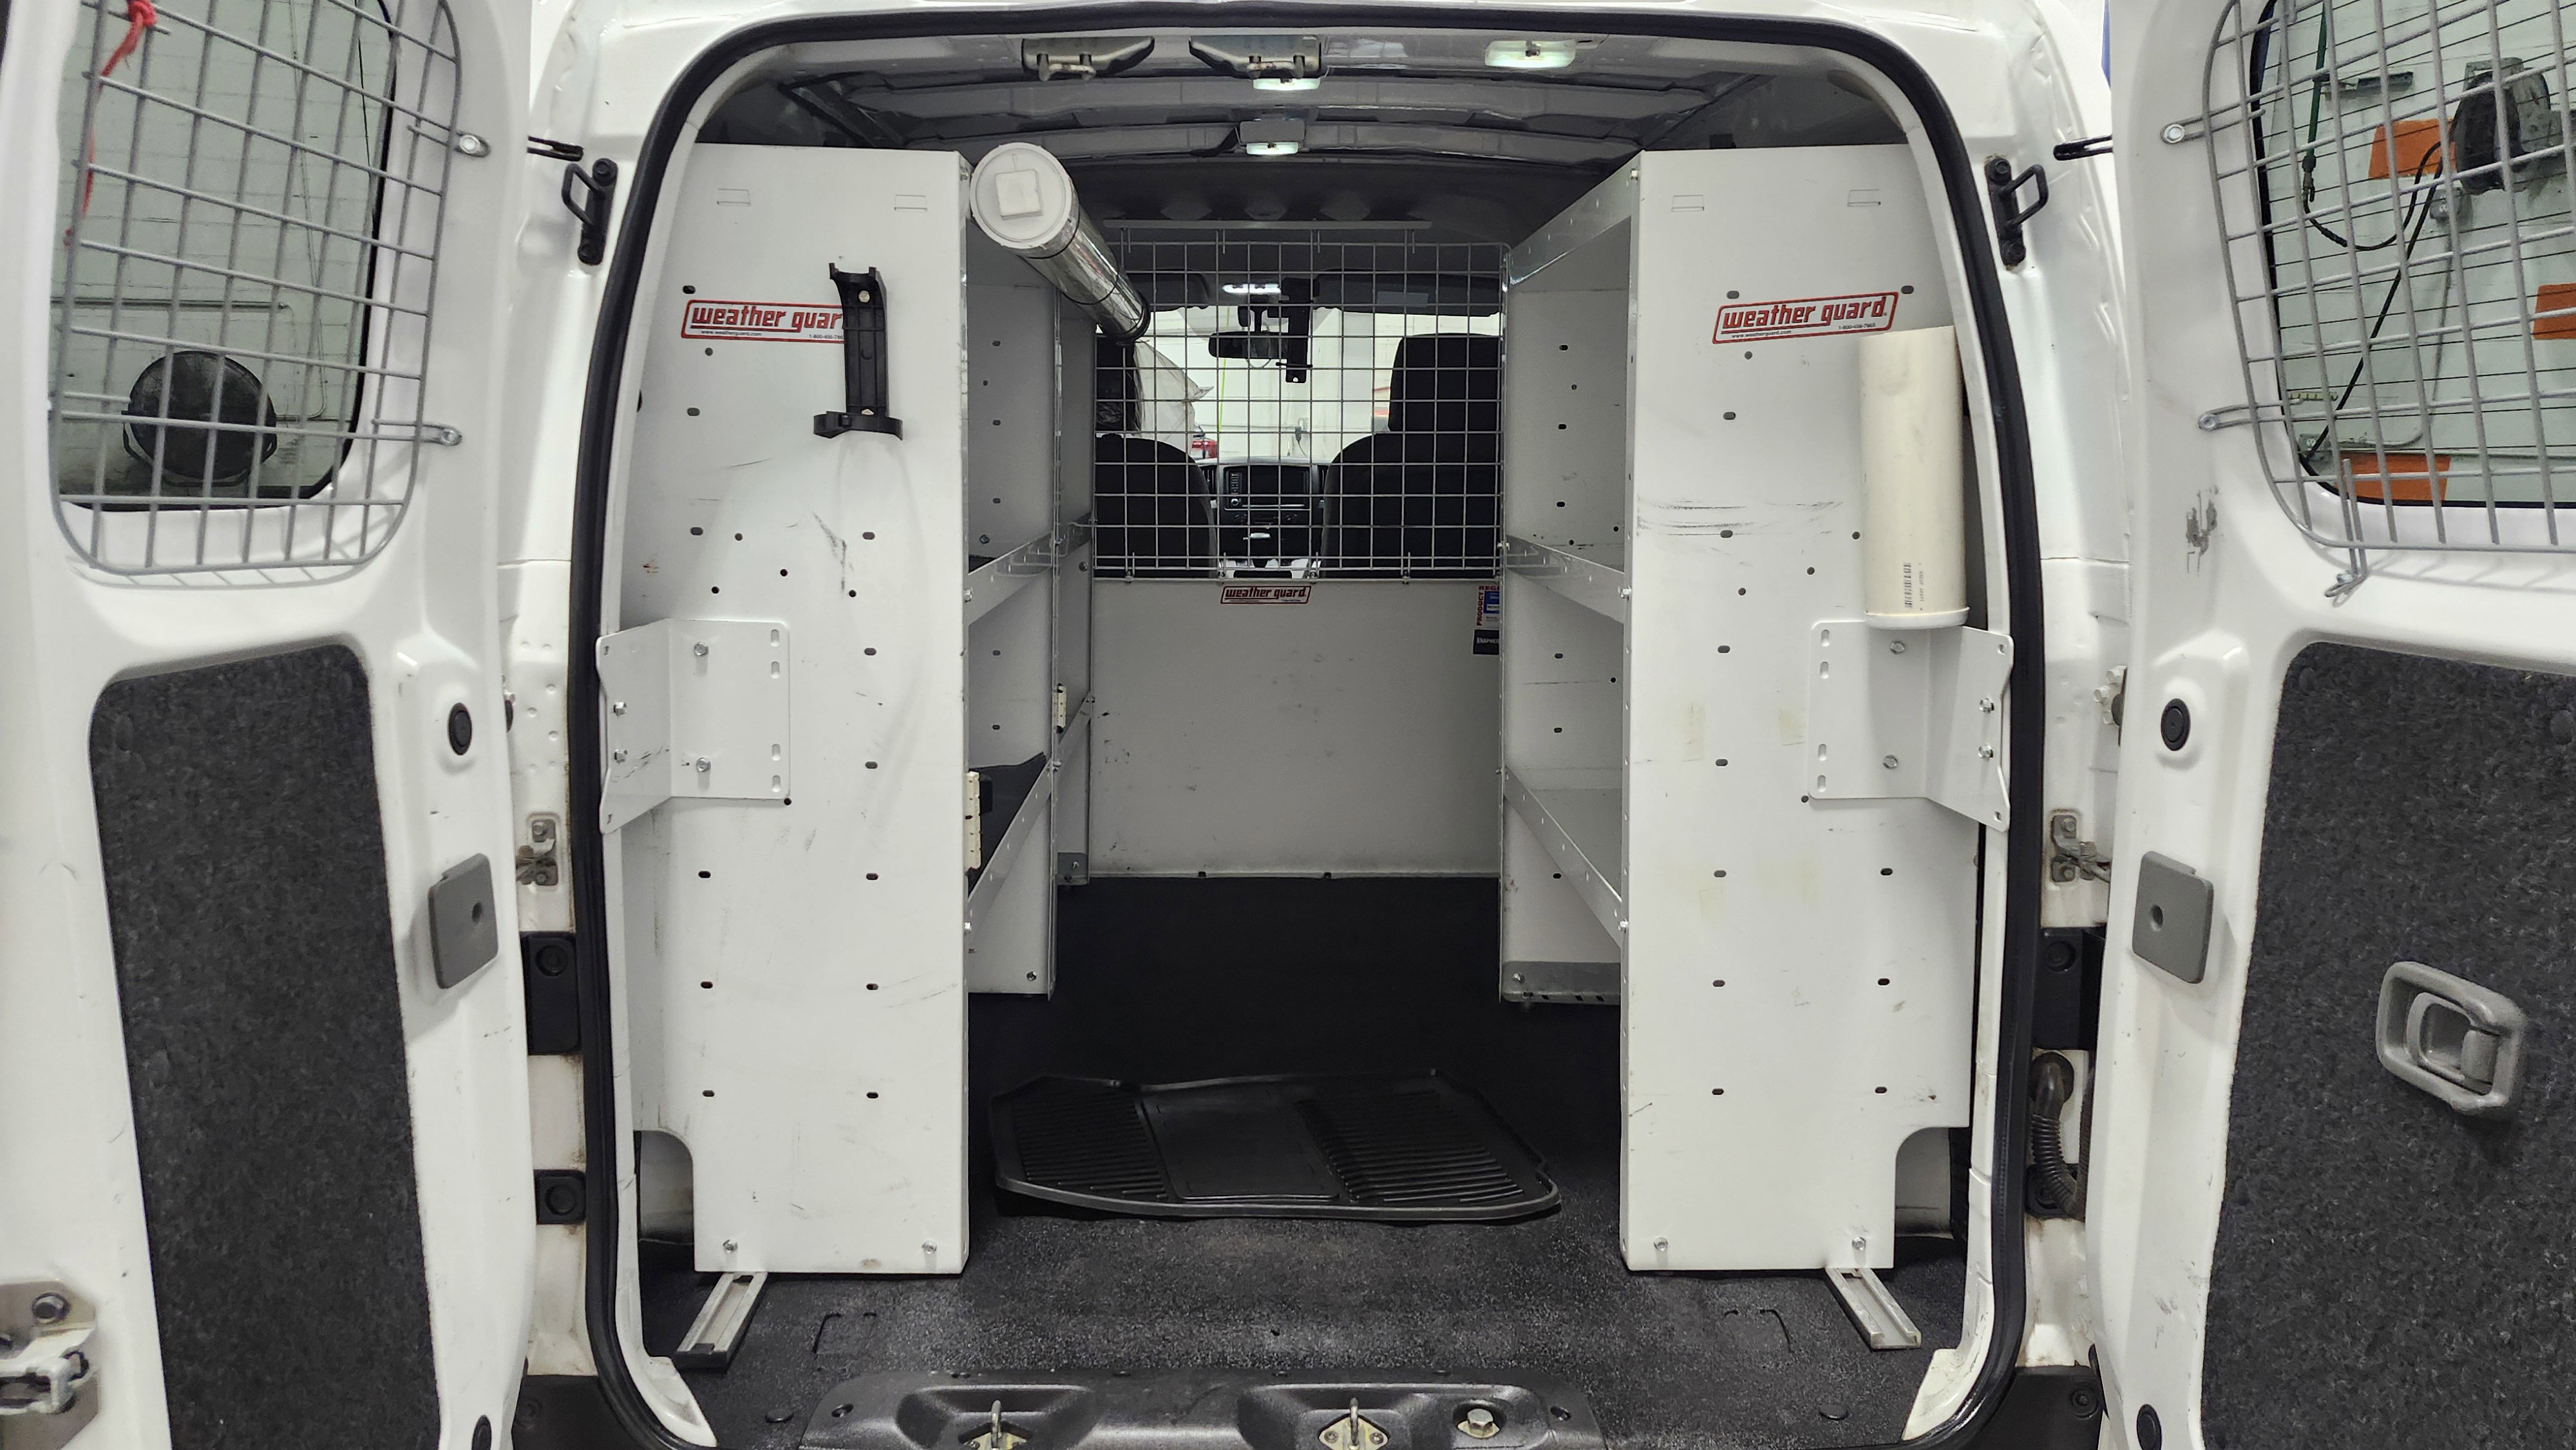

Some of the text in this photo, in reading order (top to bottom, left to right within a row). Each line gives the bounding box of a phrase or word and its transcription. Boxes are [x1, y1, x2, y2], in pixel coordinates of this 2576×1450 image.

[692, 306, 844, 332] weather guar
[1723, 297, 1886, 328] weather guard
[1226, 586, 1305, 599] weather guard
